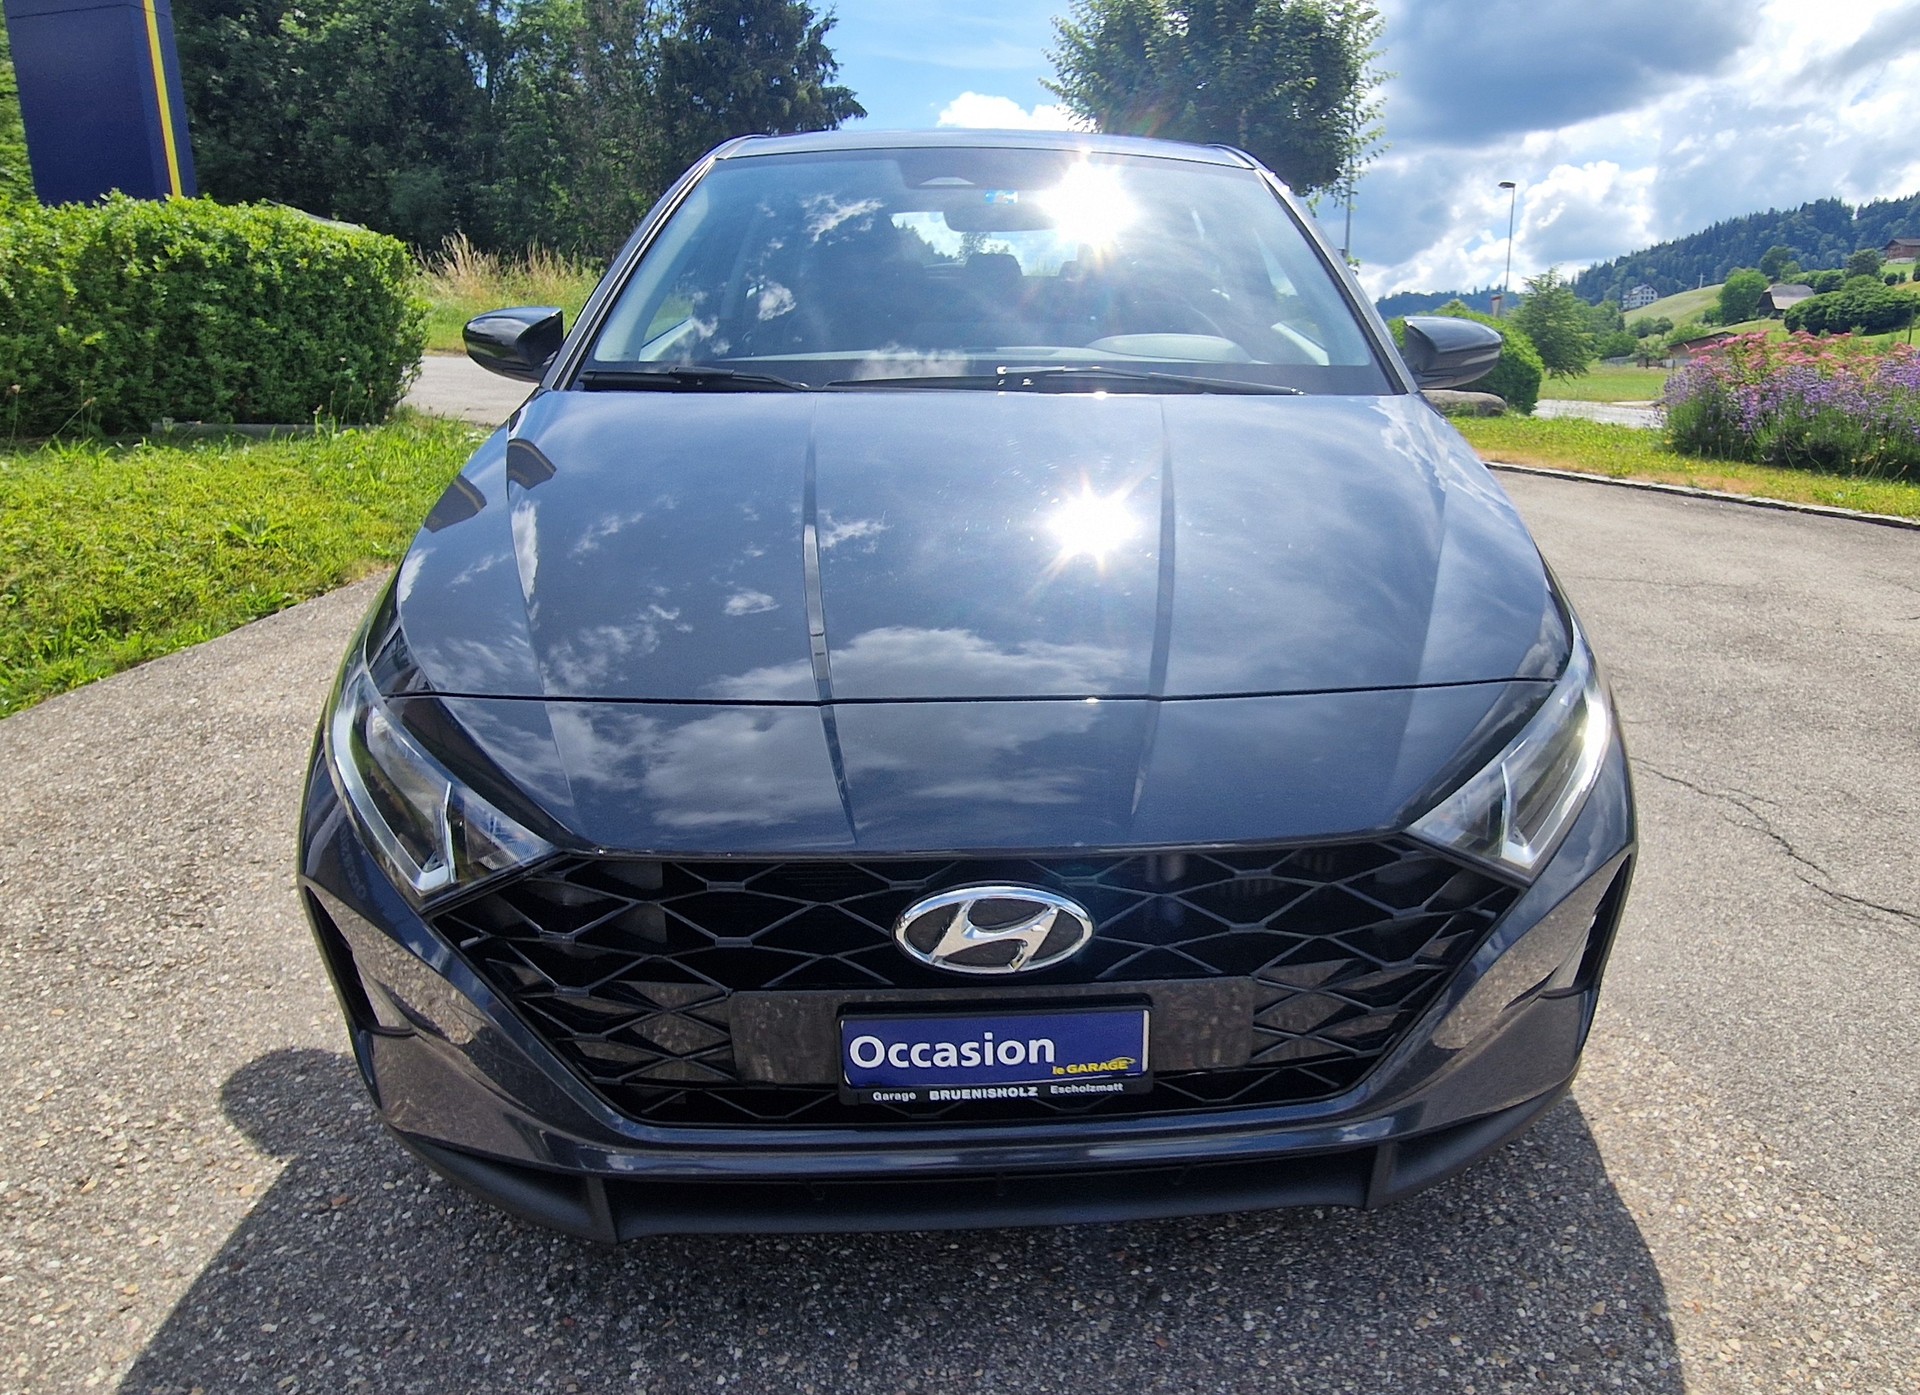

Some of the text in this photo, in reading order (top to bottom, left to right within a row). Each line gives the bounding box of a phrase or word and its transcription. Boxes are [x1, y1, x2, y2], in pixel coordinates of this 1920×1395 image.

[849, 1031, 1055, 1069] Occasion
[1066, 1060, 1129, 1074] GARAGE
[873, 1082, 1124, 1102] Garage BRUENISHOLZ Escholzmatt
